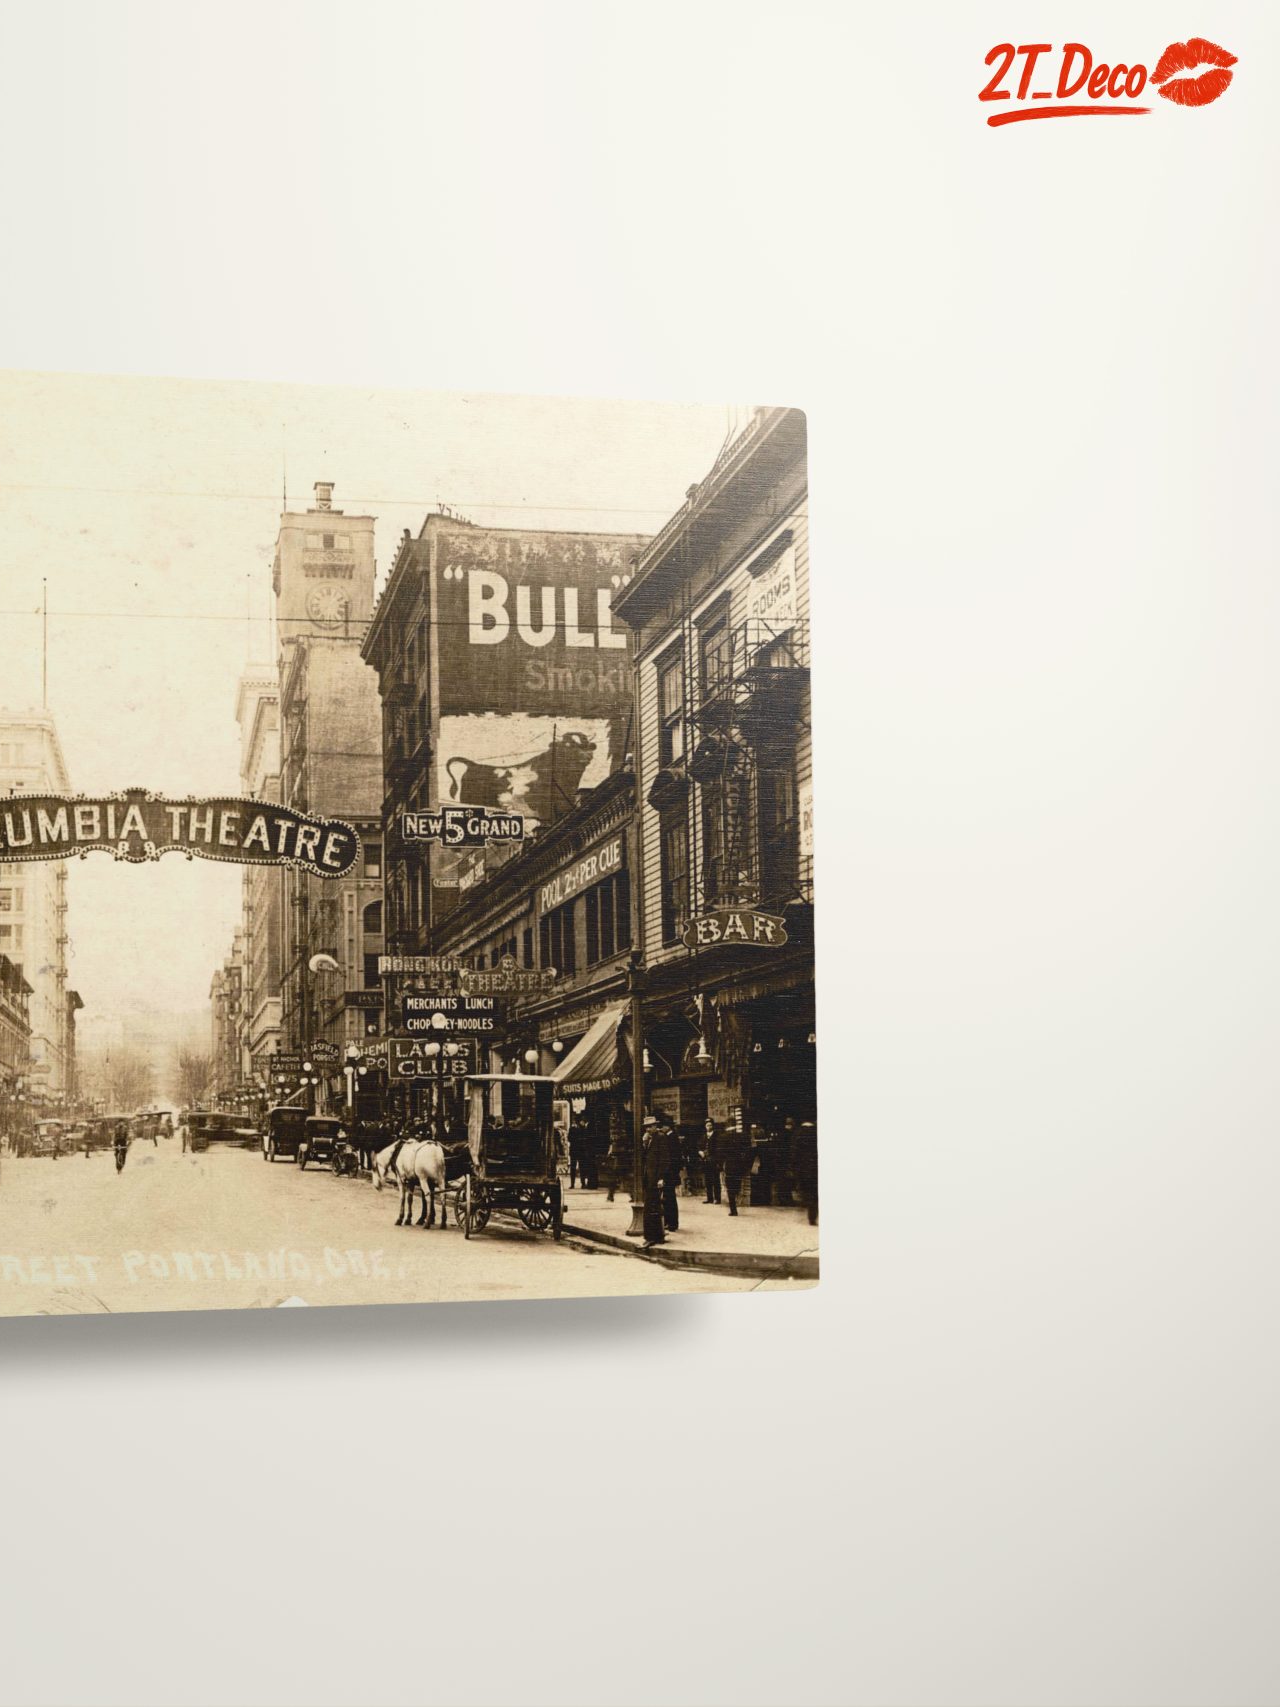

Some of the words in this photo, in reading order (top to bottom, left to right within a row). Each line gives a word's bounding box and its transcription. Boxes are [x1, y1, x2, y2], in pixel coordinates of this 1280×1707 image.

[406, 816, 443, 835] NEW
[467, 817, 521, 836] GRAND
[166, 806, 348, 868] THEATRE
[541, 877, 563, 913] POOL
[579, 856, 598, 885] PER
[599, 839, 621, 872] CUE
[695, 914, 776, 944] BAR
[381, 957, 426, 973] HONG
[406, 997, 458, 1010] MERCHANTS
[465, 997, 494, 1010] LUNCH
[406, 1018, 431, 1031] CHOP
[432, 1018, 494, 1031] EY-NOODLES
[397, 1060, 468, 1075] CLUB
[563, 1083, 582, 1094] SUITS
[582, 1080, 602, 1092] MADE
[602, 1078, 611, 1088] TO
